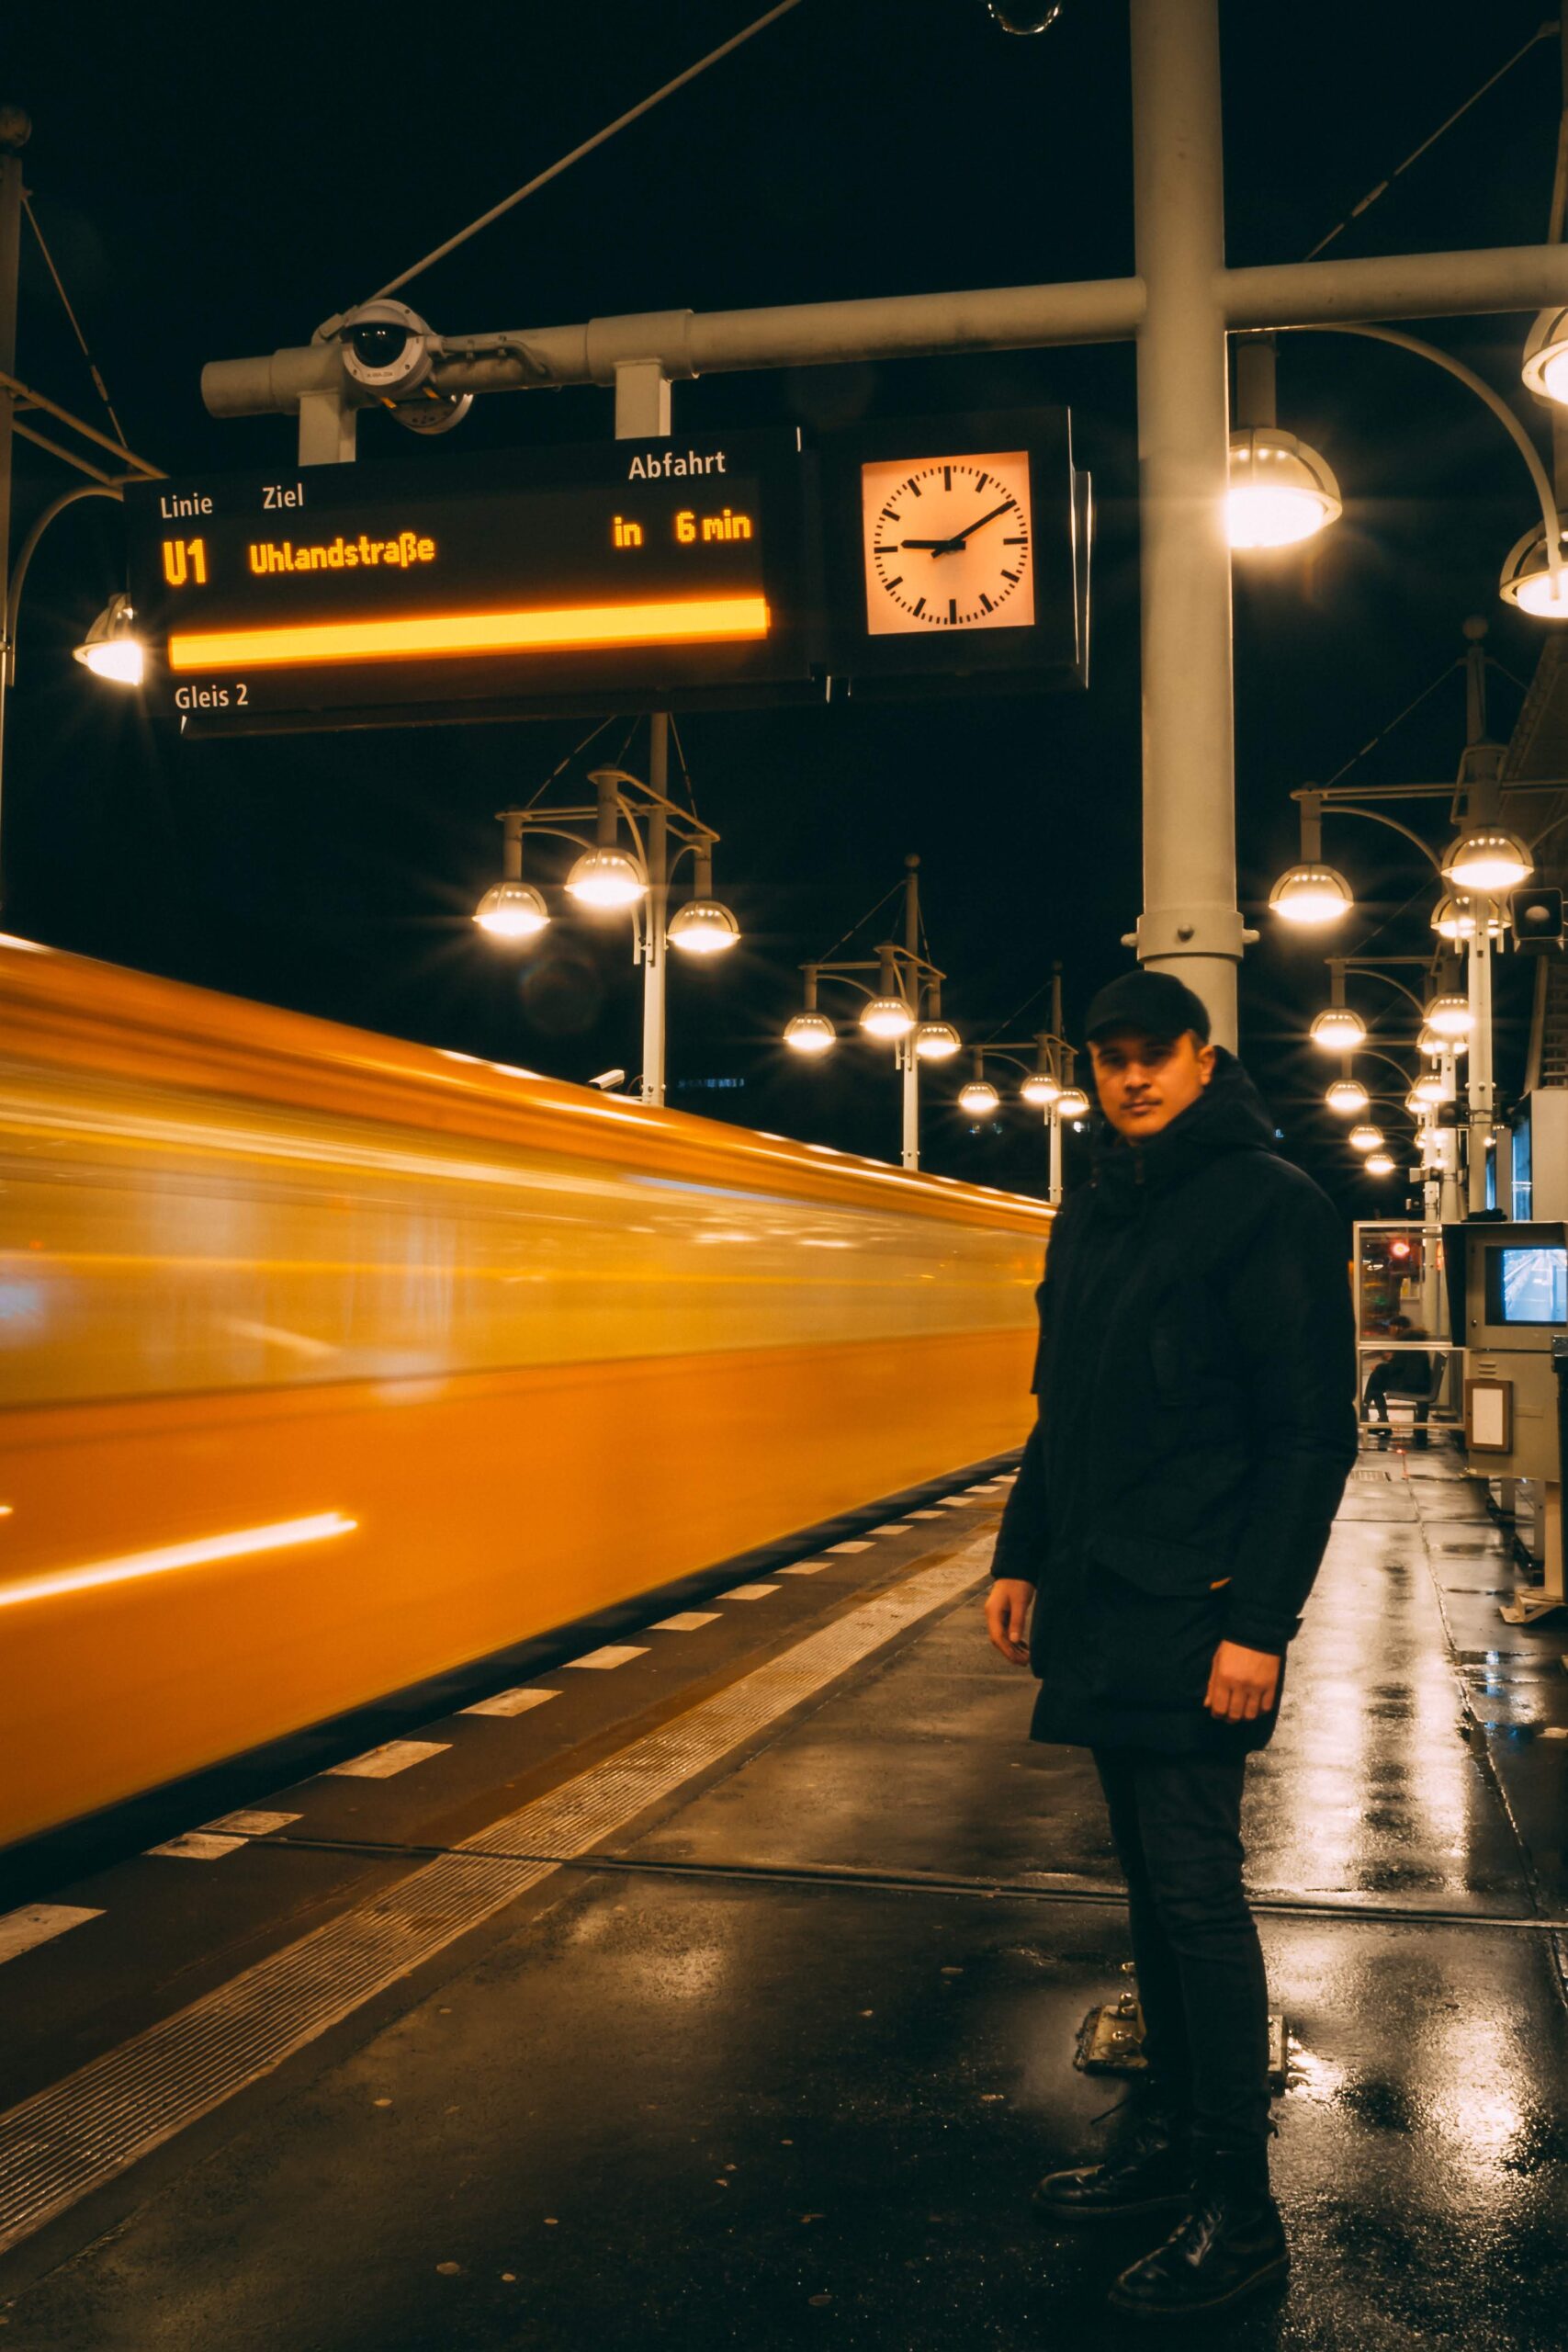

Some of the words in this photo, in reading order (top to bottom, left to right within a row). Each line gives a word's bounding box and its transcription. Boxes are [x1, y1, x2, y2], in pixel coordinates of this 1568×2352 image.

[628, 450, 726, 480] Abfahrt
[161, 493, 212, 519] Linie
[262, 482, 303, 509] Ziel
[614, 516, 642, 548] in
[675, 511, 696, 543] 6
[702, 508, 751, 541] min
[164, 538, 207, 586] U1
[250, 532, 435, 574] Uhlandstraße
[175, 684, 230, 709] Gleis
[236, 683, 249, 706] 2
